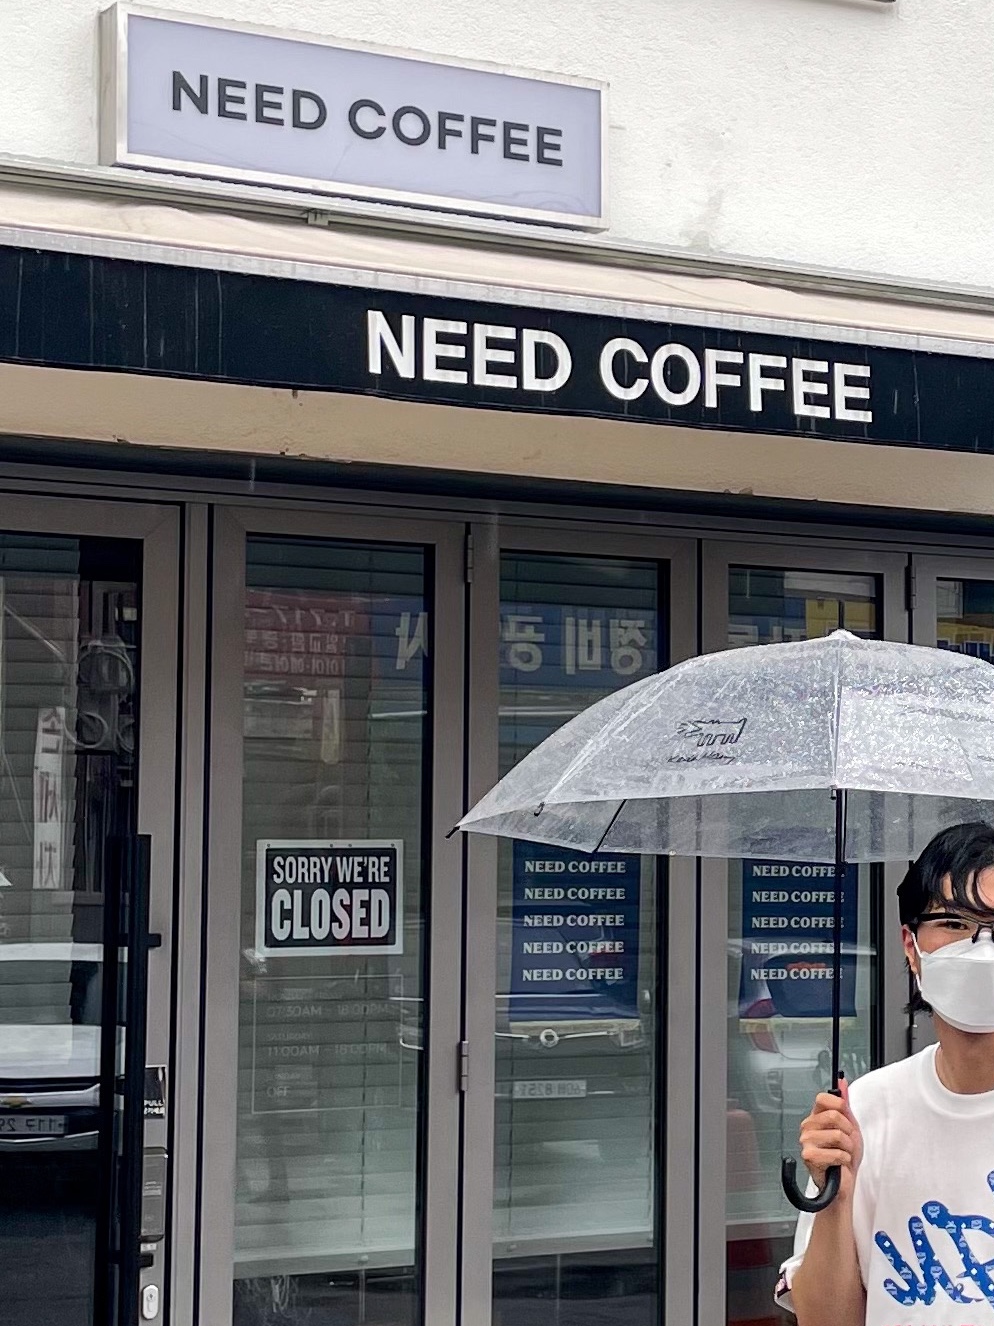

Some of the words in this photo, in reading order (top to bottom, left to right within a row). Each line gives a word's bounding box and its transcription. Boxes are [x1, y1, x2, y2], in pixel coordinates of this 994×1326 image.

[171, 70, 327, 131] NEED
[348, 98, 564, 168] COFFEE
[367, 310, 572, 392] NEED
[599, 337, 874, 423] COFFEE
[272, 855, 333, 884] SORRY
[335, 855, 391, 883] WE'RE
[524, 861, 566, 873] NEED
[568, 861, 627, 873] COFFEE
[752, 865, 790, 877] NEED
[523, 888, 565, 899] NEED
[567, 888, 626, 900] COFFEE
[752, 891, 789, 902] NEED
[271, 888, 391, 940] CLOSED
[523, 914, 565, 927] NEED
[566, 914, 625, 926] COFFEE
[751, 917, 789, 928] NEED
[522, 942, 564, 954] NEED
[565, 941, 625, 953] COFFEE
[751, 943, 788, 954] NEED
[522, 969, 563, 981] NEED
[565, 968, 624, 980] COFFEE
[750, 968, 788, 980] NEED
